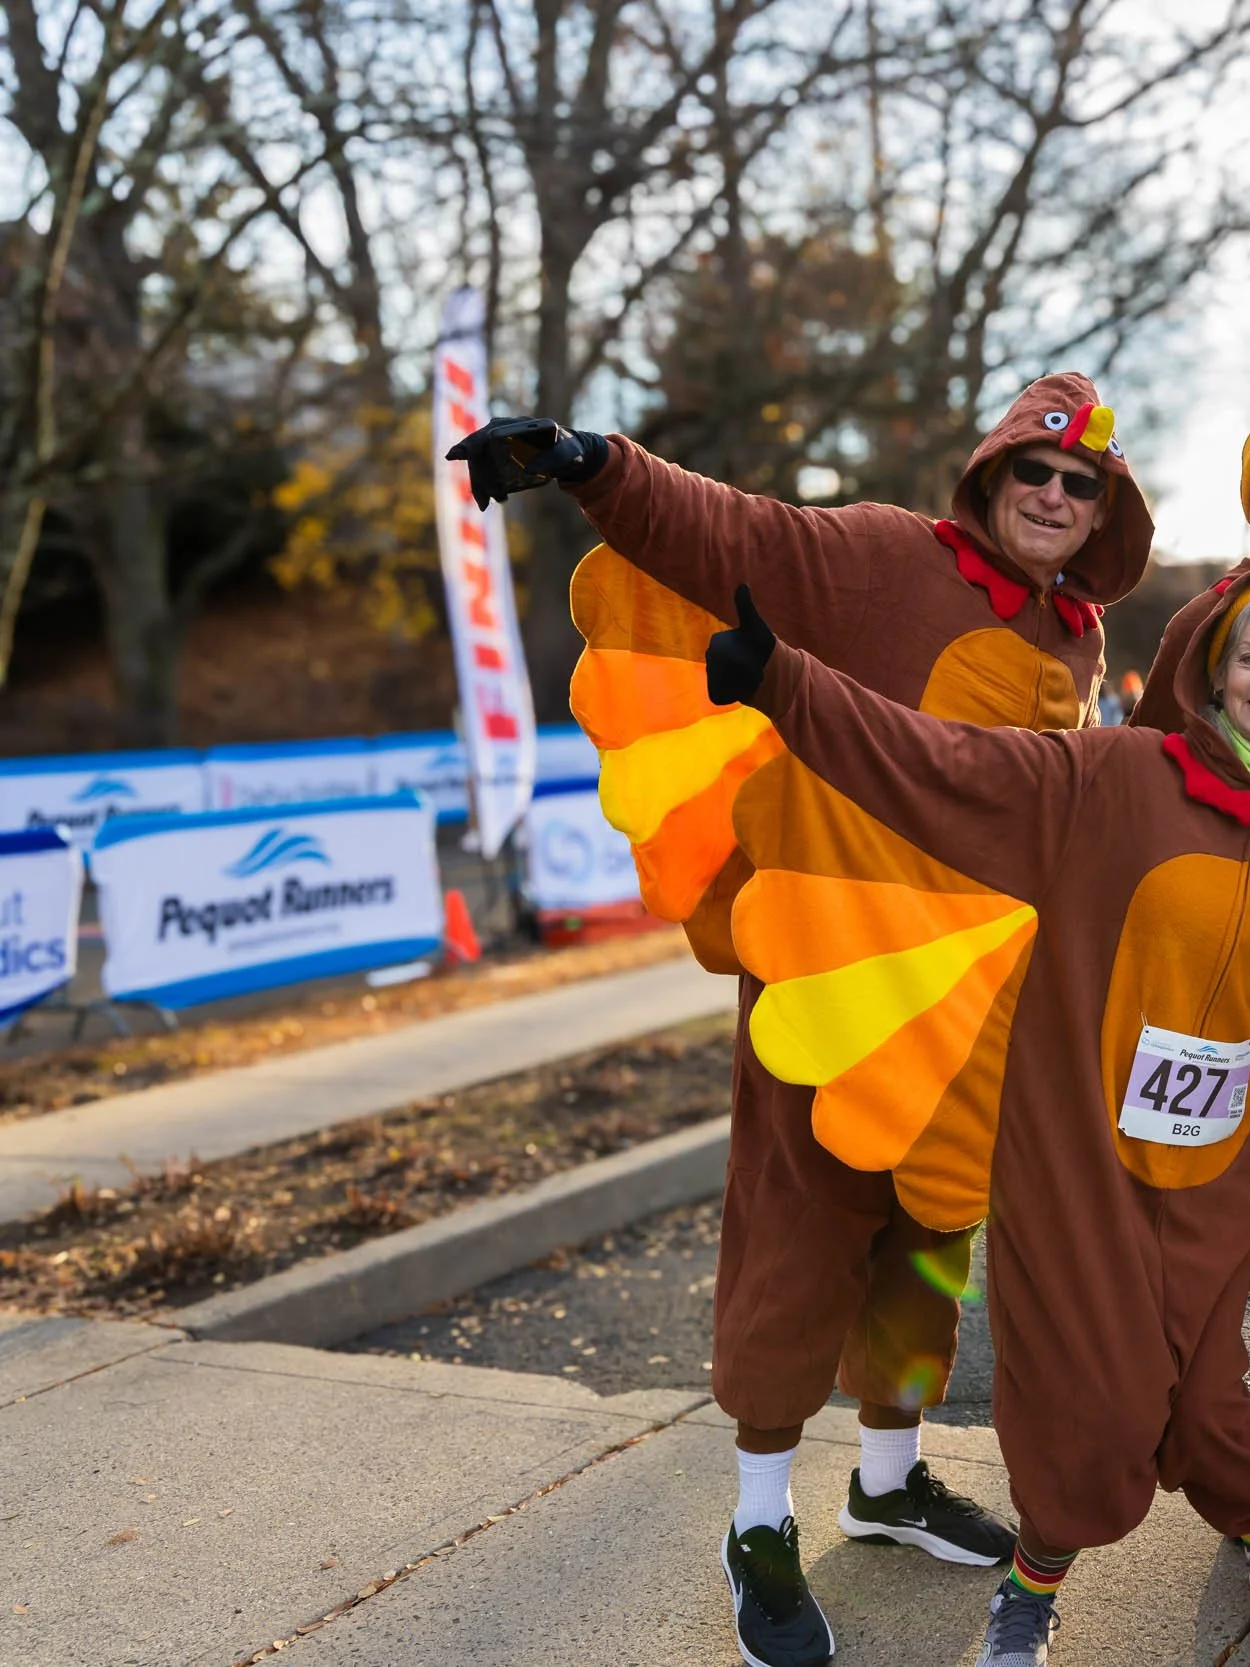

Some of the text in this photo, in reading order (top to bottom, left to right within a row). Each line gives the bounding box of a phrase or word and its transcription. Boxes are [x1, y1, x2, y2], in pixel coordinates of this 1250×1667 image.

[158, 887, 272, 943] Pequot
[282, 876, 396, 918] Runners
[1180, 1048, 1205, 1061] Pequot
[1204, 1054, 1231, 1064] Runners
[1140, 1059, 1229, 1118] 427
[1172, 1123, 1200, 1137] B2G
